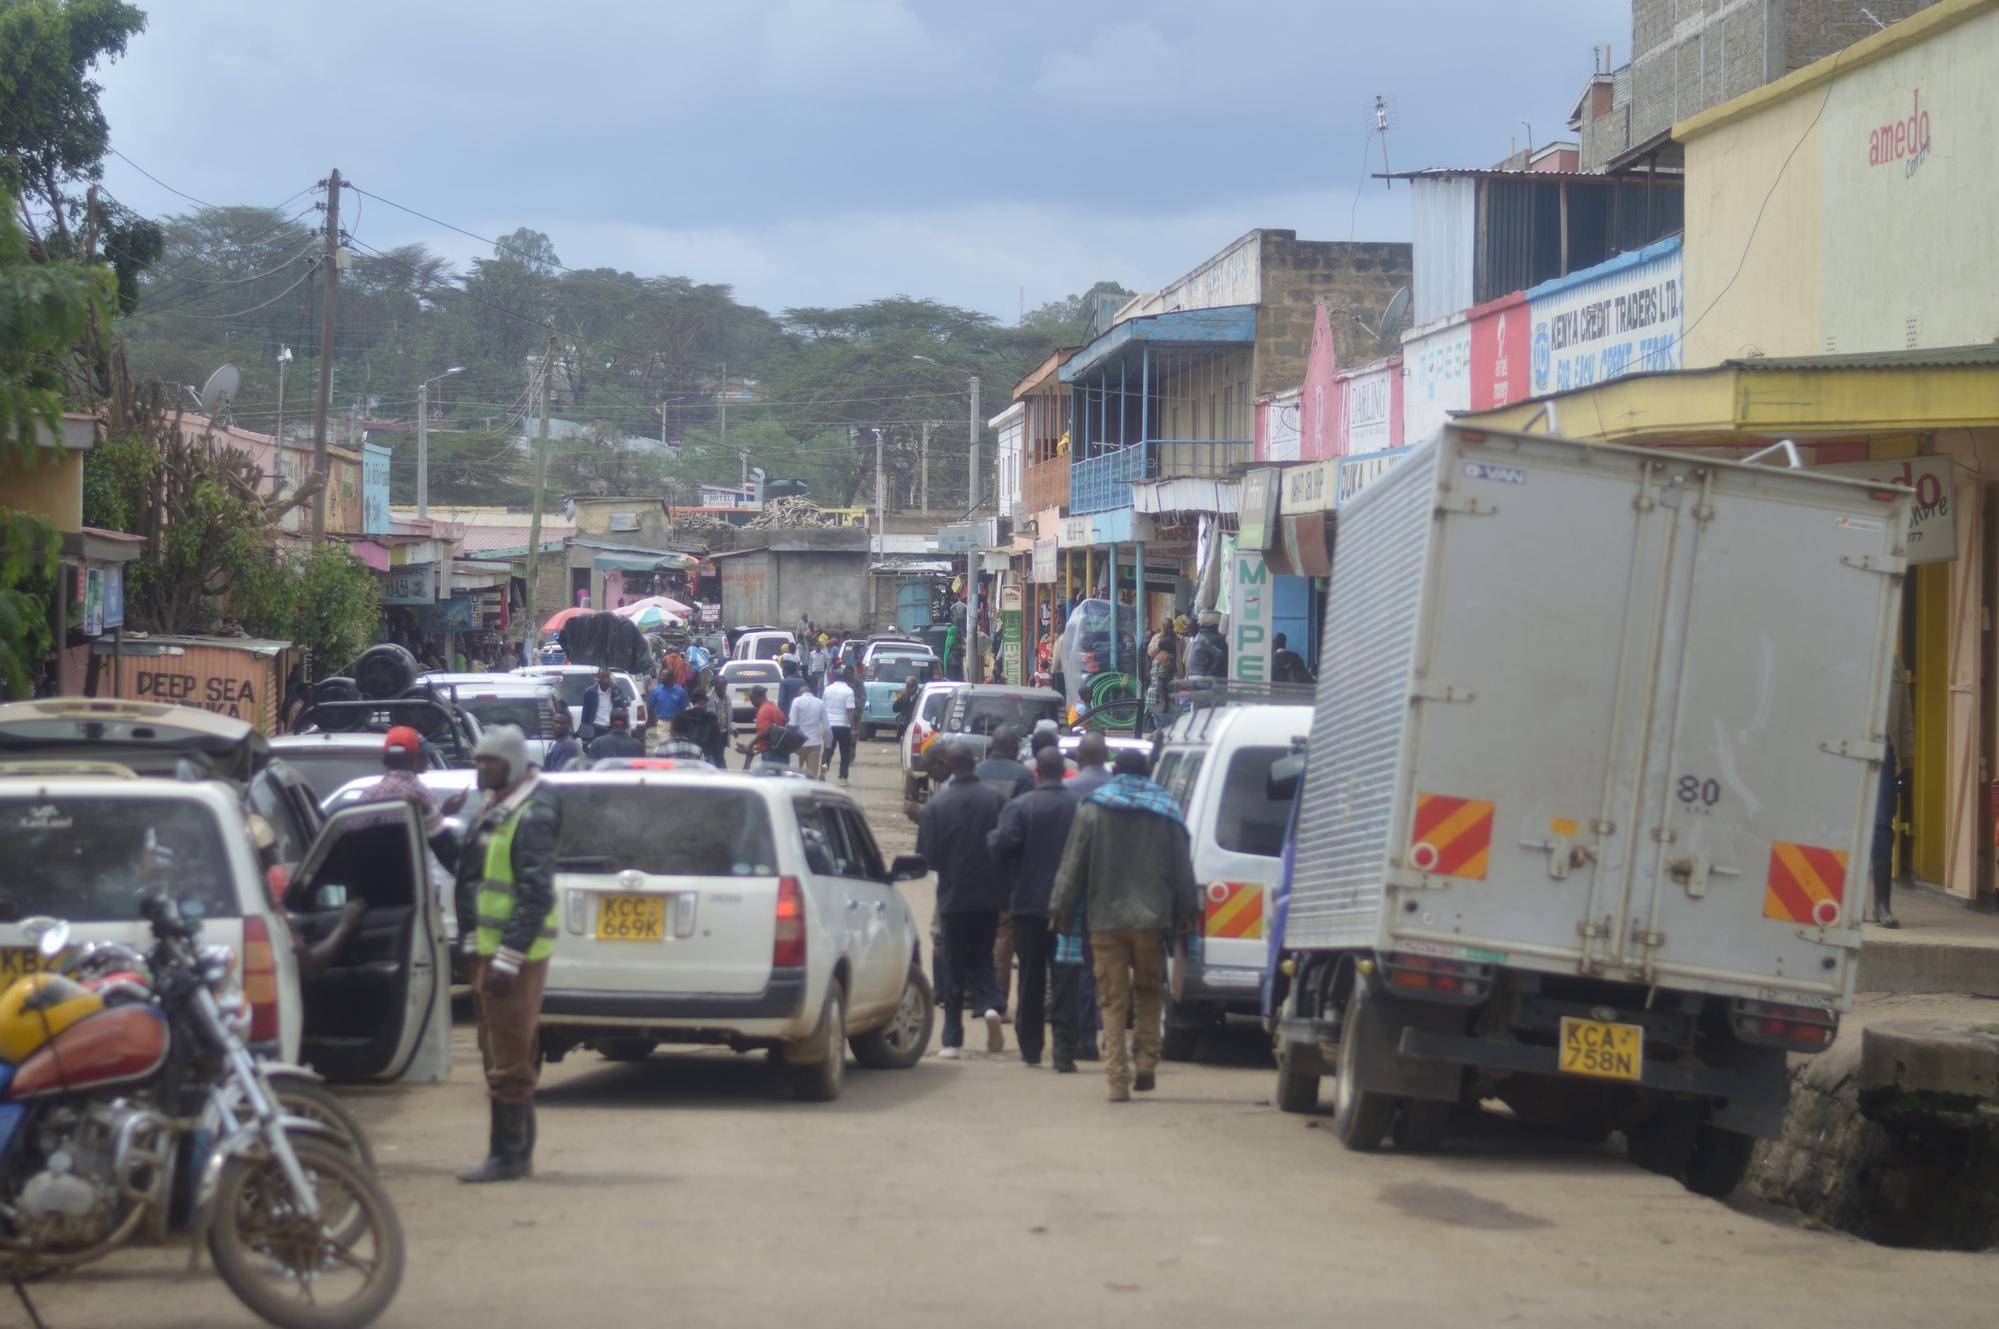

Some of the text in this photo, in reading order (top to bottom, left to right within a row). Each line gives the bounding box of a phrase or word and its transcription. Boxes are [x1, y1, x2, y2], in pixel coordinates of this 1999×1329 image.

[1868, 88, 1930, 167] amedo
[1551, 309, 1579, 352] KENYA
[1580, 299, 1612, 342] CREDIT
[1614, 286, 1657, 335] TRADERS
[1600, 342, 1634, 380] CREDIT
[1351, 377, 1386, 425] DARLING
[137, 671, 256, 704] DEEP SEA
[1678, 774, 1721, 807] 80
[604, 896, 644, 917] KCC
[604, 919, 659, 937] 669K
[1567, 1022, 1616, 1050] KCA
[1567, 1046, 1632, 1075] 758N
